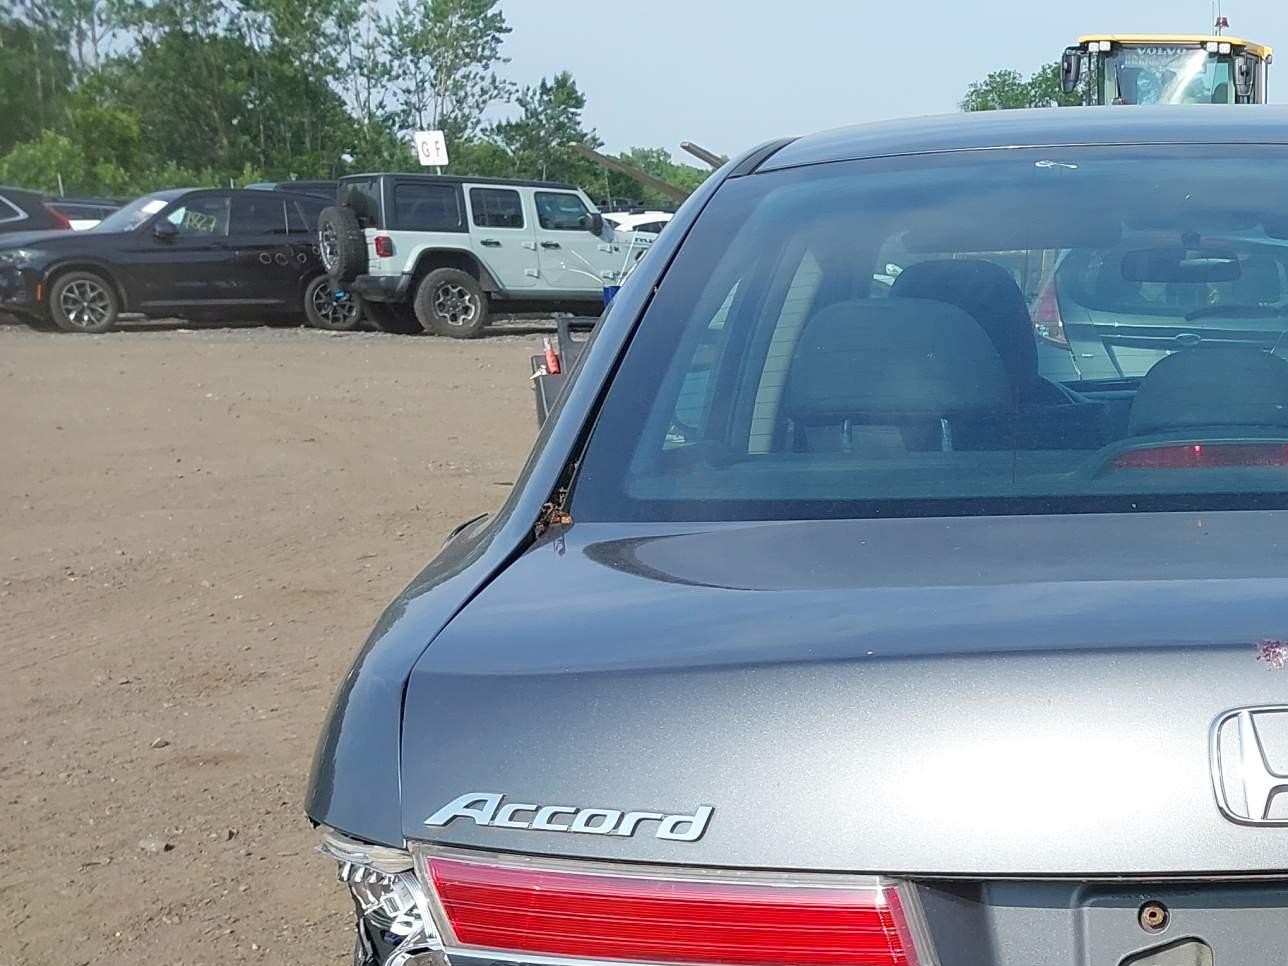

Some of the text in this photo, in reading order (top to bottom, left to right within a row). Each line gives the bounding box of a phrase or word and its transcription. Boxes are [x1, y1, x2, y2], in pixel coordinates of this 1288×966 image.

[1137, 47, 1187, 55] VOLVO
[421, 140, 430, 158] G
[423, 792, 715, 842] Accord
